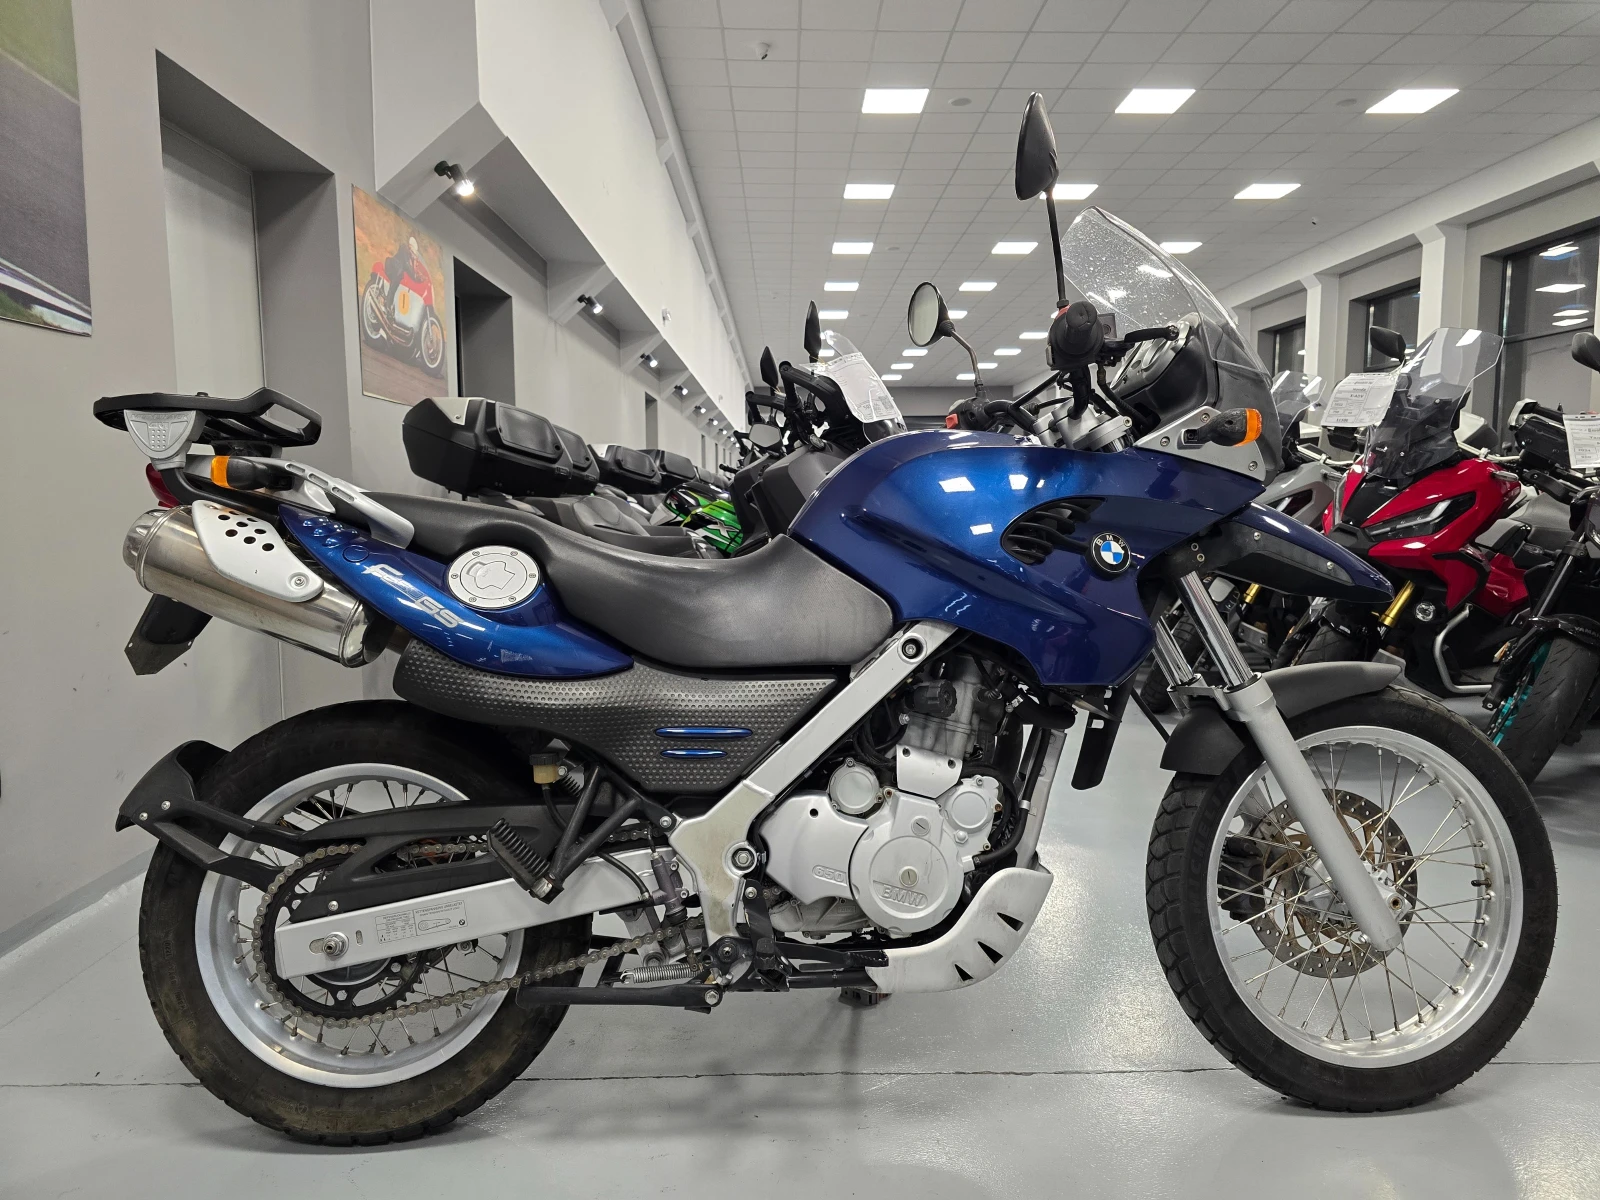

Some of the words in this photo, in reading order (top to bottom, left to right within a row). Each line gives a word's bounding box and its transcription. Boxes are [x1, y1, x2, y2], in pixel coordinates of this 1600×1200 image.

[1095, 534, 1126, 548] BMW
[813, 865, 846, 882] 650
[881, 884, 924, 907] BMW
